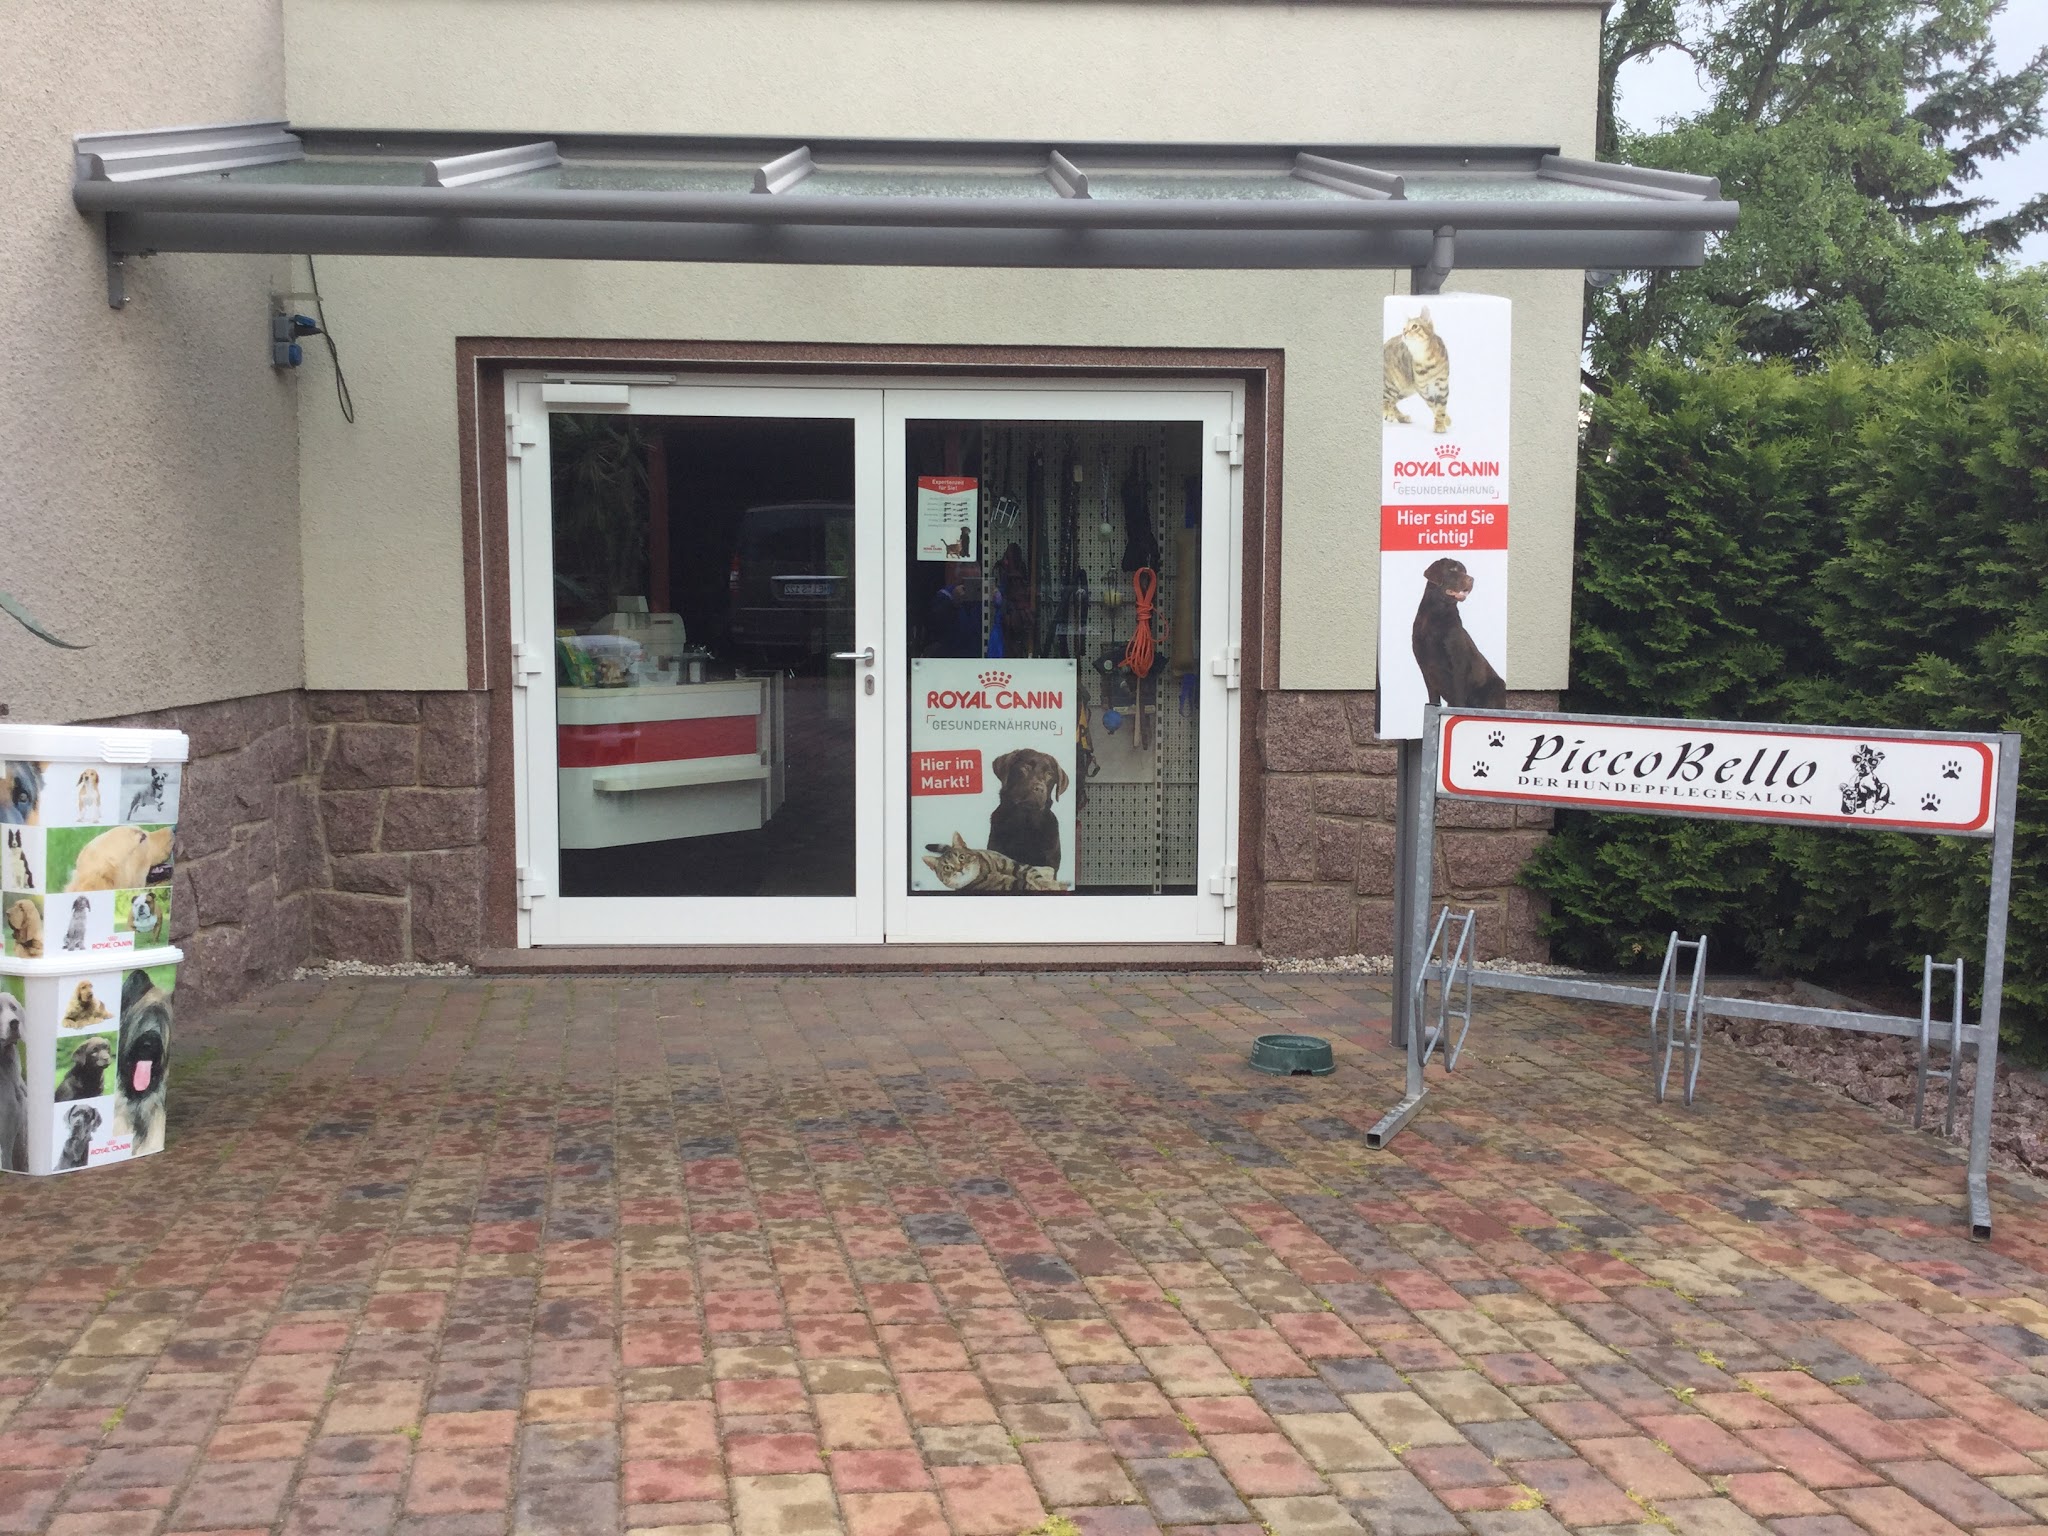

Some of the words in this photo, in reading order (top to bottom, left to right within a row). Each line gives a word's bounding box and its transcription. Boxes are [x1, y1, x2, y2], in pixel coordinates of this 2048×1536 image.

[1394, 461, 1445, 477] ROYAL
[1448, 461, 1499, 477] CANIN
[1398, 484, 1495, 496] GESUNDERNÄHRUNG
[1397, 509, 1431, 525] Hier
[1434, 509, 1467, 525] sind
[1471, 509, 1495, 525] Sie
[1418, 529, 1474, 547] richtig!
[927, 690, 992, 709] ROYAL
[996, 690, 1063, 709] CANIN
[932, 718, 1057, 731] GESUNDERNÄHRUNG
[920, 758, 951, 771] Hier
[955, 757, 974, 770] im
[921, 775, 970, 789] Markt!
[1518, 775, 1559, 787] DER
[1567, 779, 1813, 805] HUNDEPFLEGESALON
